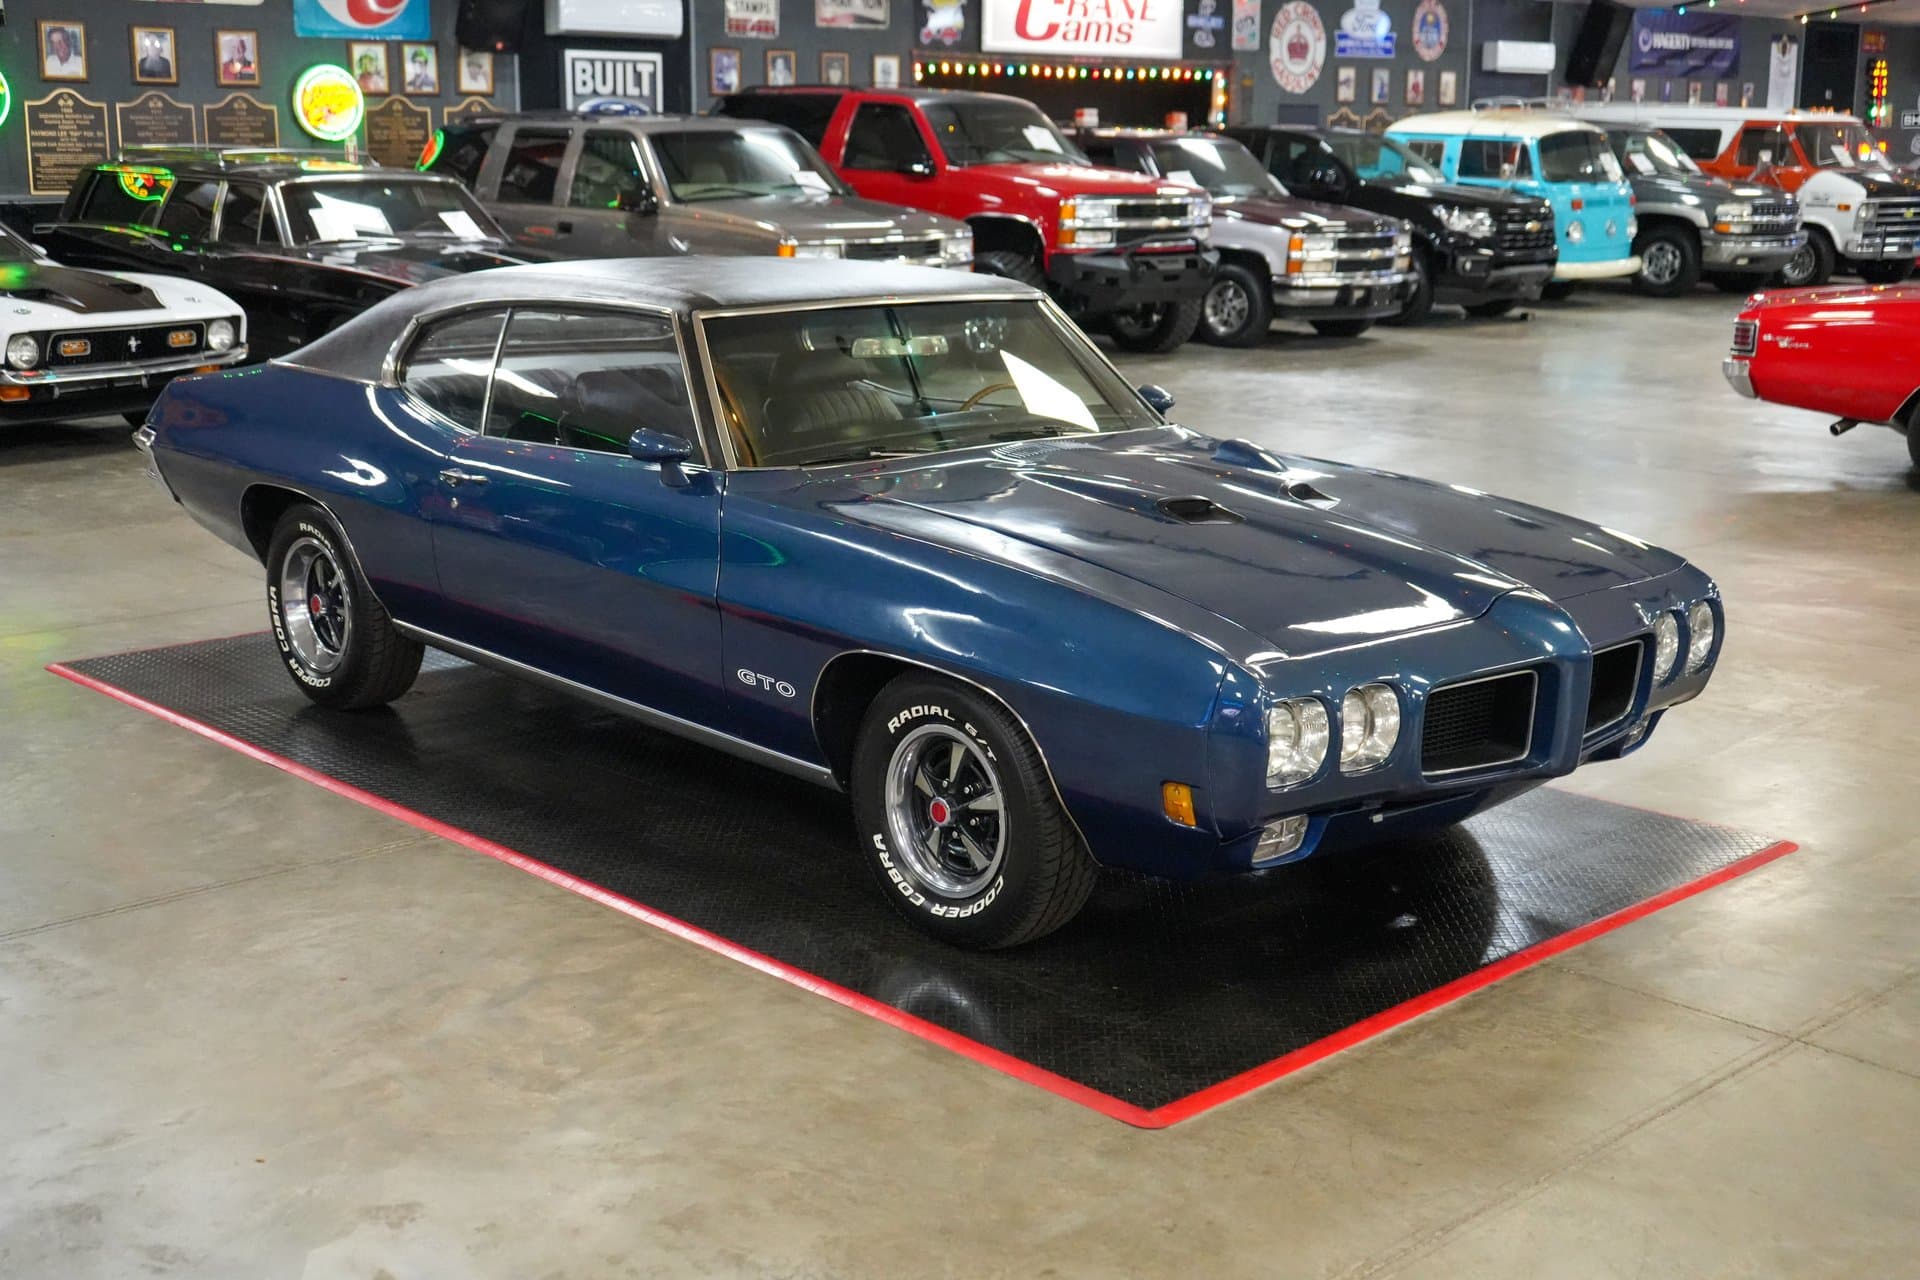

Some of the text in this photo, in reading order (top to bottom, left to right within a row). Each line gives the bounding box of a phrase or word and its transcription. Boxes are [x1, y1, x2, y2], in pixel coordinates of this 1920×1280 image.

[574, 60, 655, 97] BUILT
[269, 585, 332, 688] COOPER COBRA
[737, 668, 796, 698] GTO
[887, 704, 998, 762] RADIAL G/T
[872, 833, 1004, 918] COOPER COBRA
